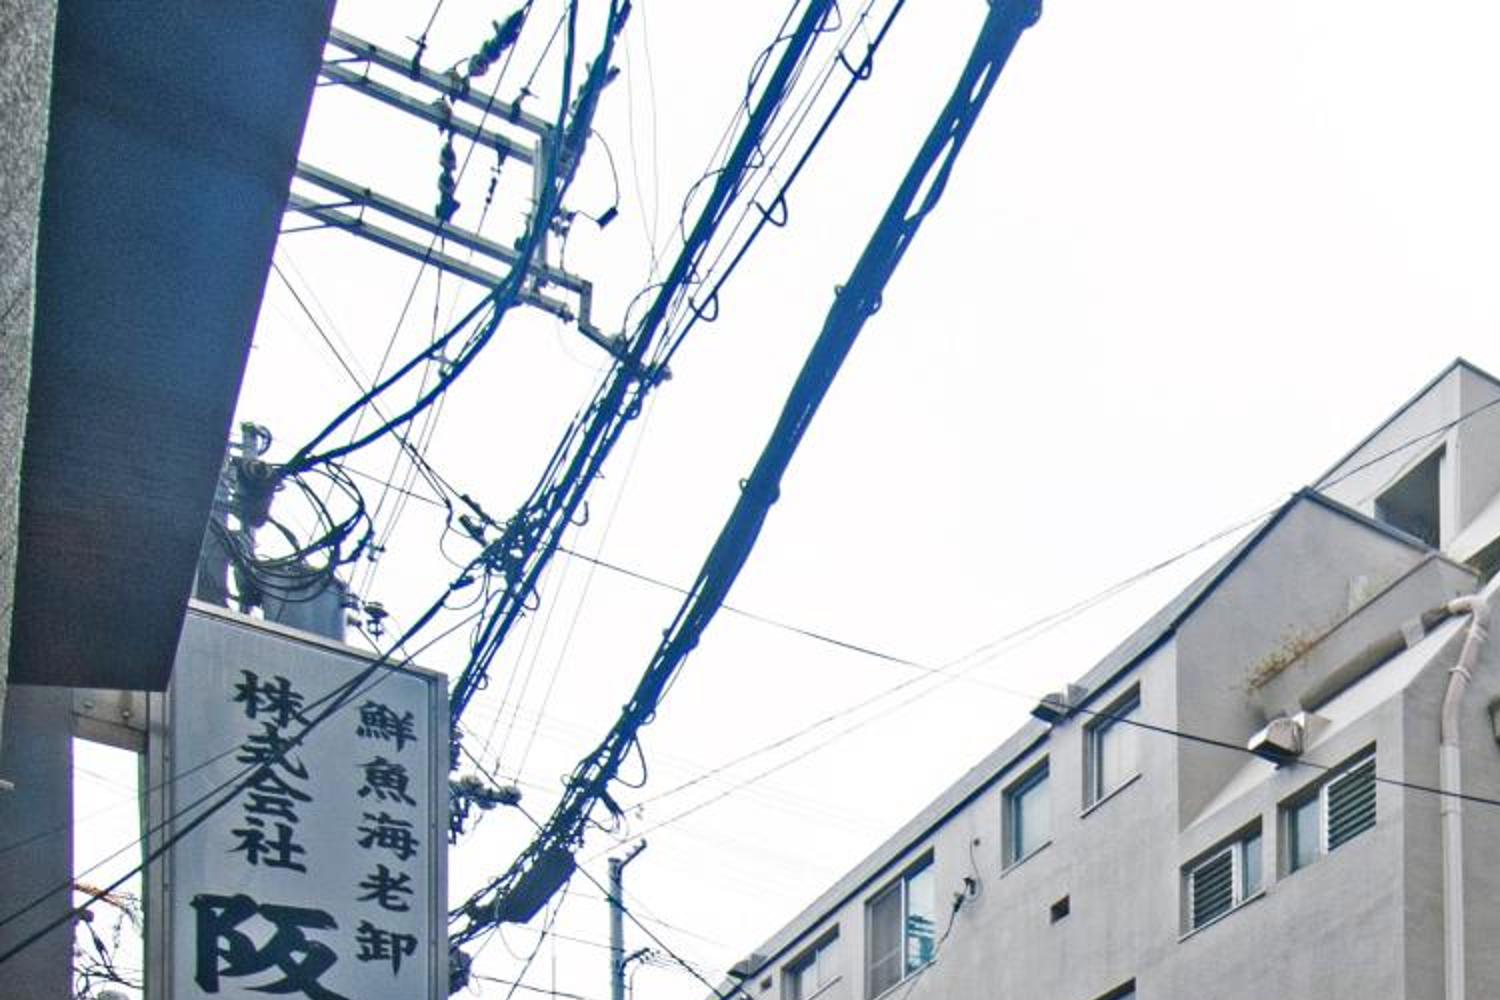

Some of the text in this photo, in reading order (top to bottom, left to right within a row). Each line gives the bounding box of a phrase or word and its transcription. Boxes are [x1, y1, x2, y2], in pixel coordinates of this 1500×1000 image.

[227, 669, 313, 873] 株式会社
[356, 700, 420, 977] 鮮魚海老卸
